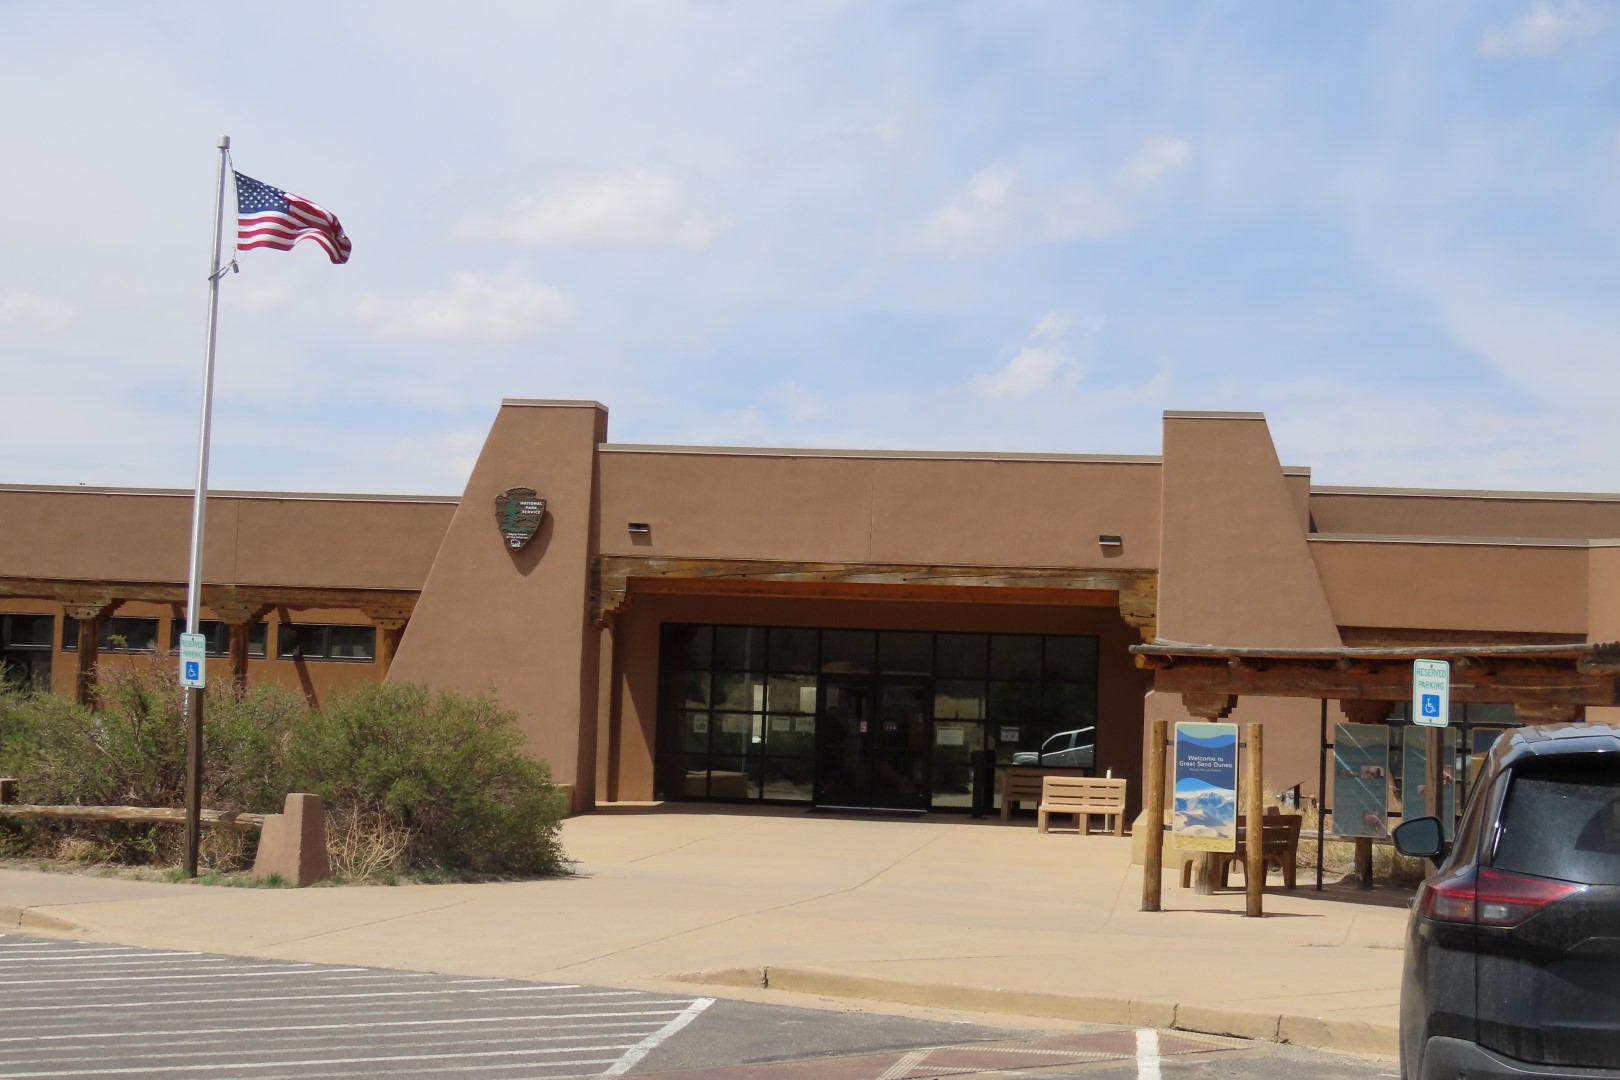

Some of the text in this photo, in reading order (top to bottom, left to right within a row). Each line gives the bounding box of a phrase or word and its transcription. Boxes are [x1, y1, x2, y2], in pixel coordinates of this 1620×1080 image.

[182, 640, 204, 648] RESERVED
[1416, 668, 1446, 678] RESERVED
[1418, 681, 1444, 690] PARKING
